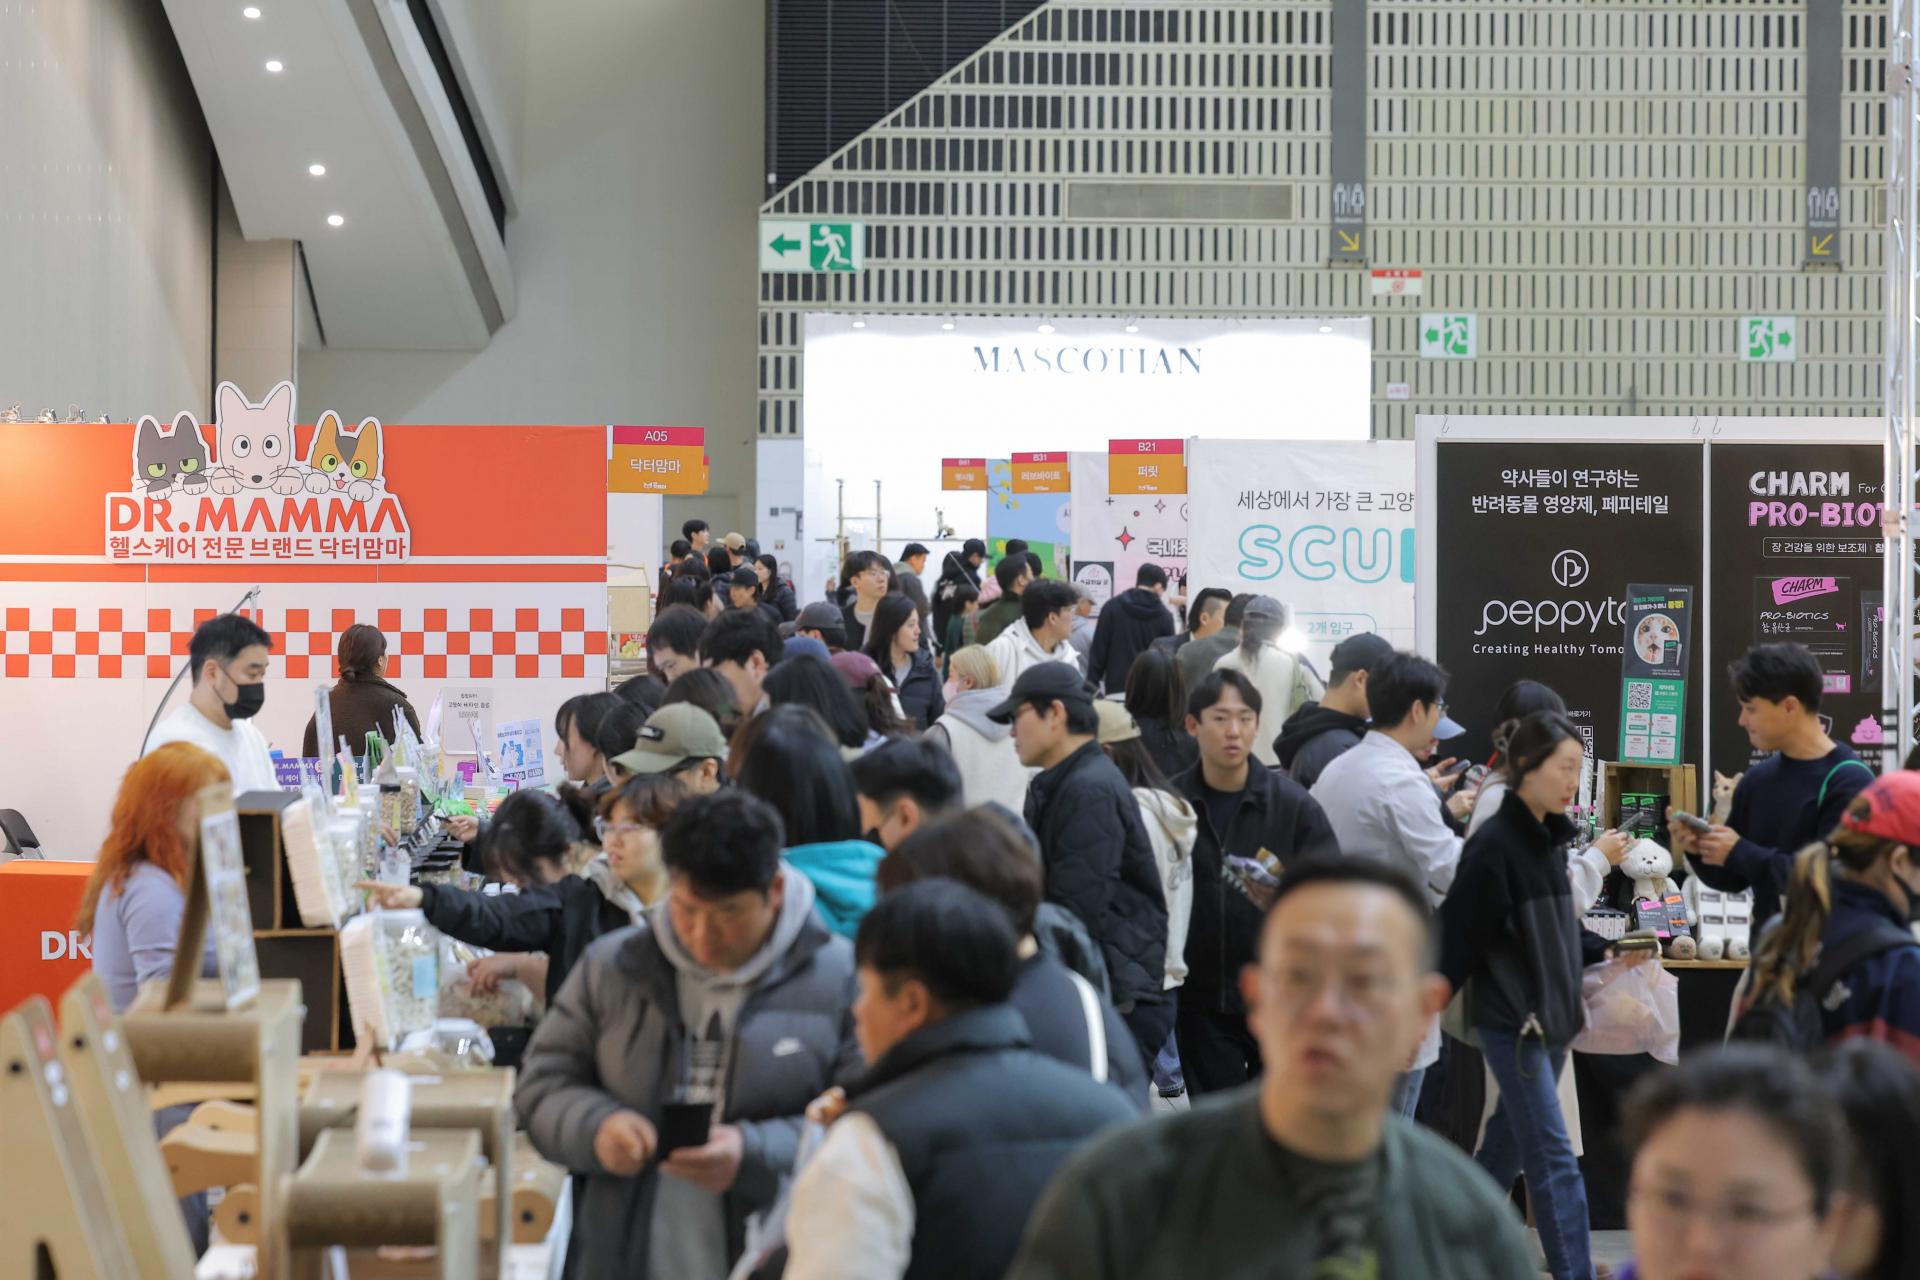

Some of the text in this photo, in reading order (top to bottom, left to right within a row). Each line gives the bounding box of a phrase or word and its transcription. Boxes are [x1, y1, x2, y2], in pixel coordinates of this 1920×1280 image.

[973, 346, 1202, 374] MASCOTIAN
[644, 430, 668, 442] A05
[1138, 442, 1157, 451] B21
[1032, 453, 1048, 462] B31
[630, 458, 680, 473] 닥터맘마
[1138, 465, 1158, 478] 퍼릿
[1501, 469, 1640, 488] 약사들이 연구하는
[1749, 471, 1850, 496] CHARM
[1858, 483, 1877, 494] For
[1237, 490, 1310, 511] 세상에서
[1315, 490, 1351, 511] 가장
[1356, 491, 1374, 512] 큰
[1472, 495, 1669, 516] 반려동물 영양제, 페피테일
[110, 496, 406, 532] DR.MAMMA
[110, 536, 406, 559] 헬스케어 전문 브랜드 닥터맘마
[1771, 543, 1782, 553] 장
[1784, 543, 1813, 553] 건강을
[1816, 543, 1836, 553] 위한
[1838, 543, 1867, 553] 보조제
[1781, 578, 1824, 593] CHARM
[1760, 612, 1829, 620] PRO-BIOTICS
[1330, 621, 1353, 635] 입구
[1472, 643, 1529, 656] Creating
[1534, 643, 1585, 656] Healthy
[41, 930, 93, 960] DR
